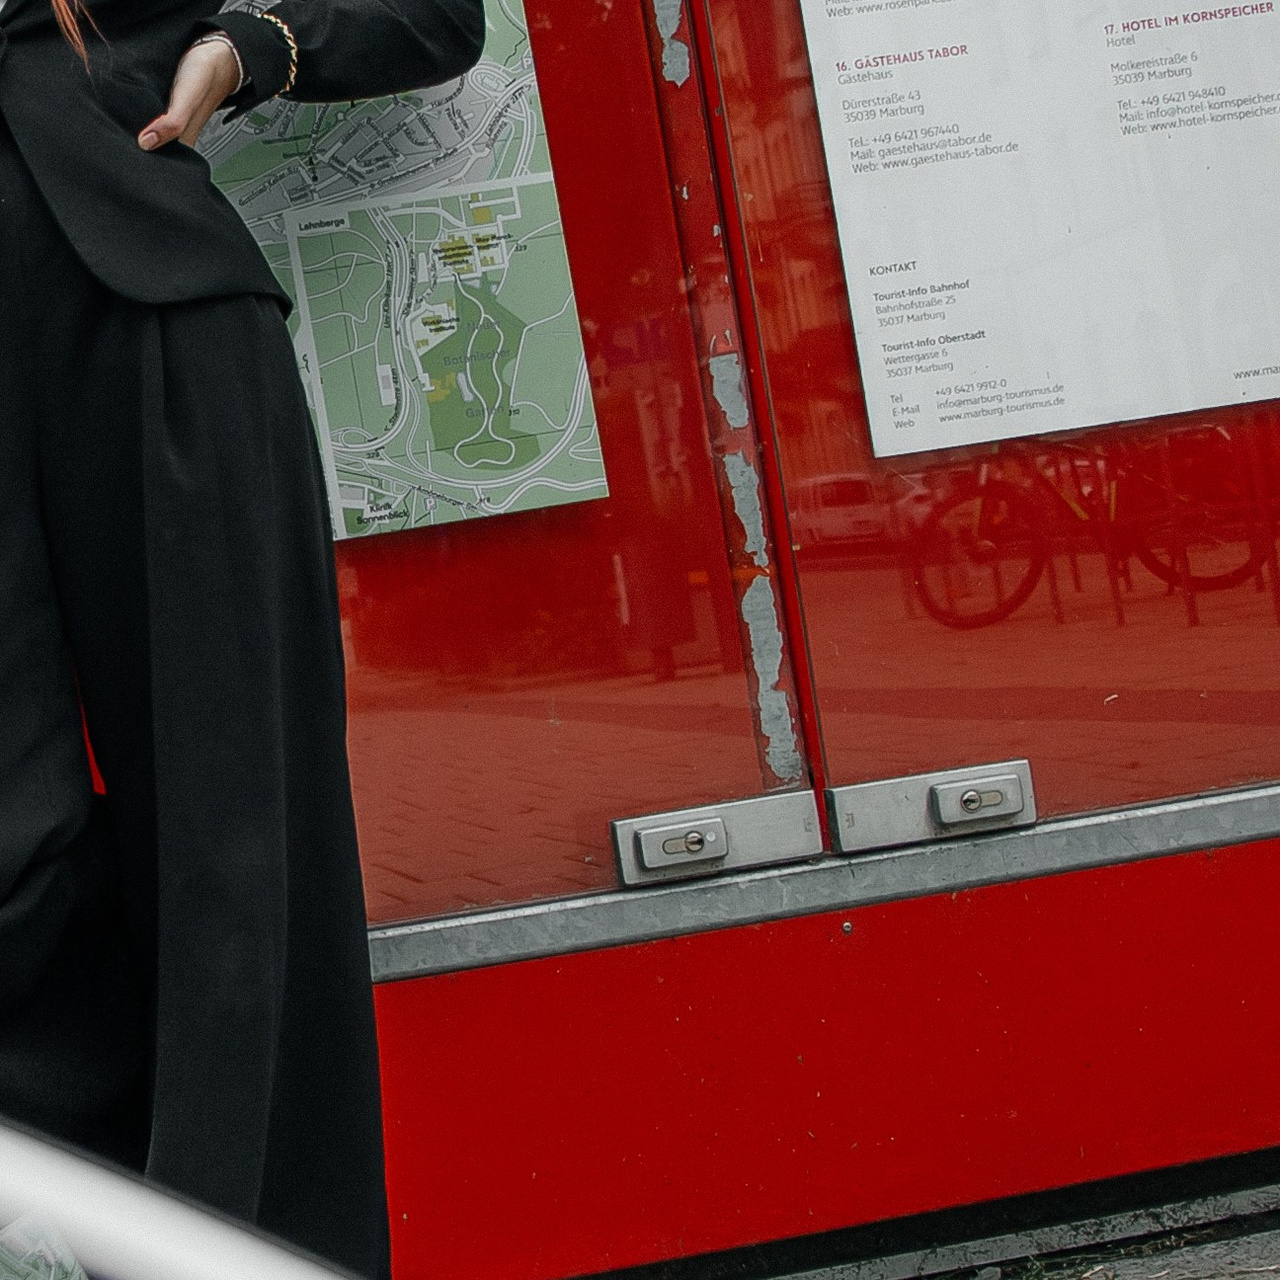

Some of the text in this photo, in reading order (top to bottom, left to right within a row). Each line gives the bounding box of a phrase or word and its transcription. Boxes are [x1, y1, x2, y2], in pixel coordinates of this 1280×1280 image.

[1103, 0, 1274, 35] 17. HOTEL IM KORNSPEICHER
[1105, 33, 1136, 48] Hotel
[834, 43, 969, 72] 16. GÄSTEHAUS TABOR
[836, 69, 893, 85] Gästehaus
[298, 217, 345, 231] Lahnberge
[868, 259, 917, 276] KONTAKT
[871, 277, 970, 302] Tourist-Info Bahnhof
[880, 329, 986, 353] Tourist-Info Oberstadt
